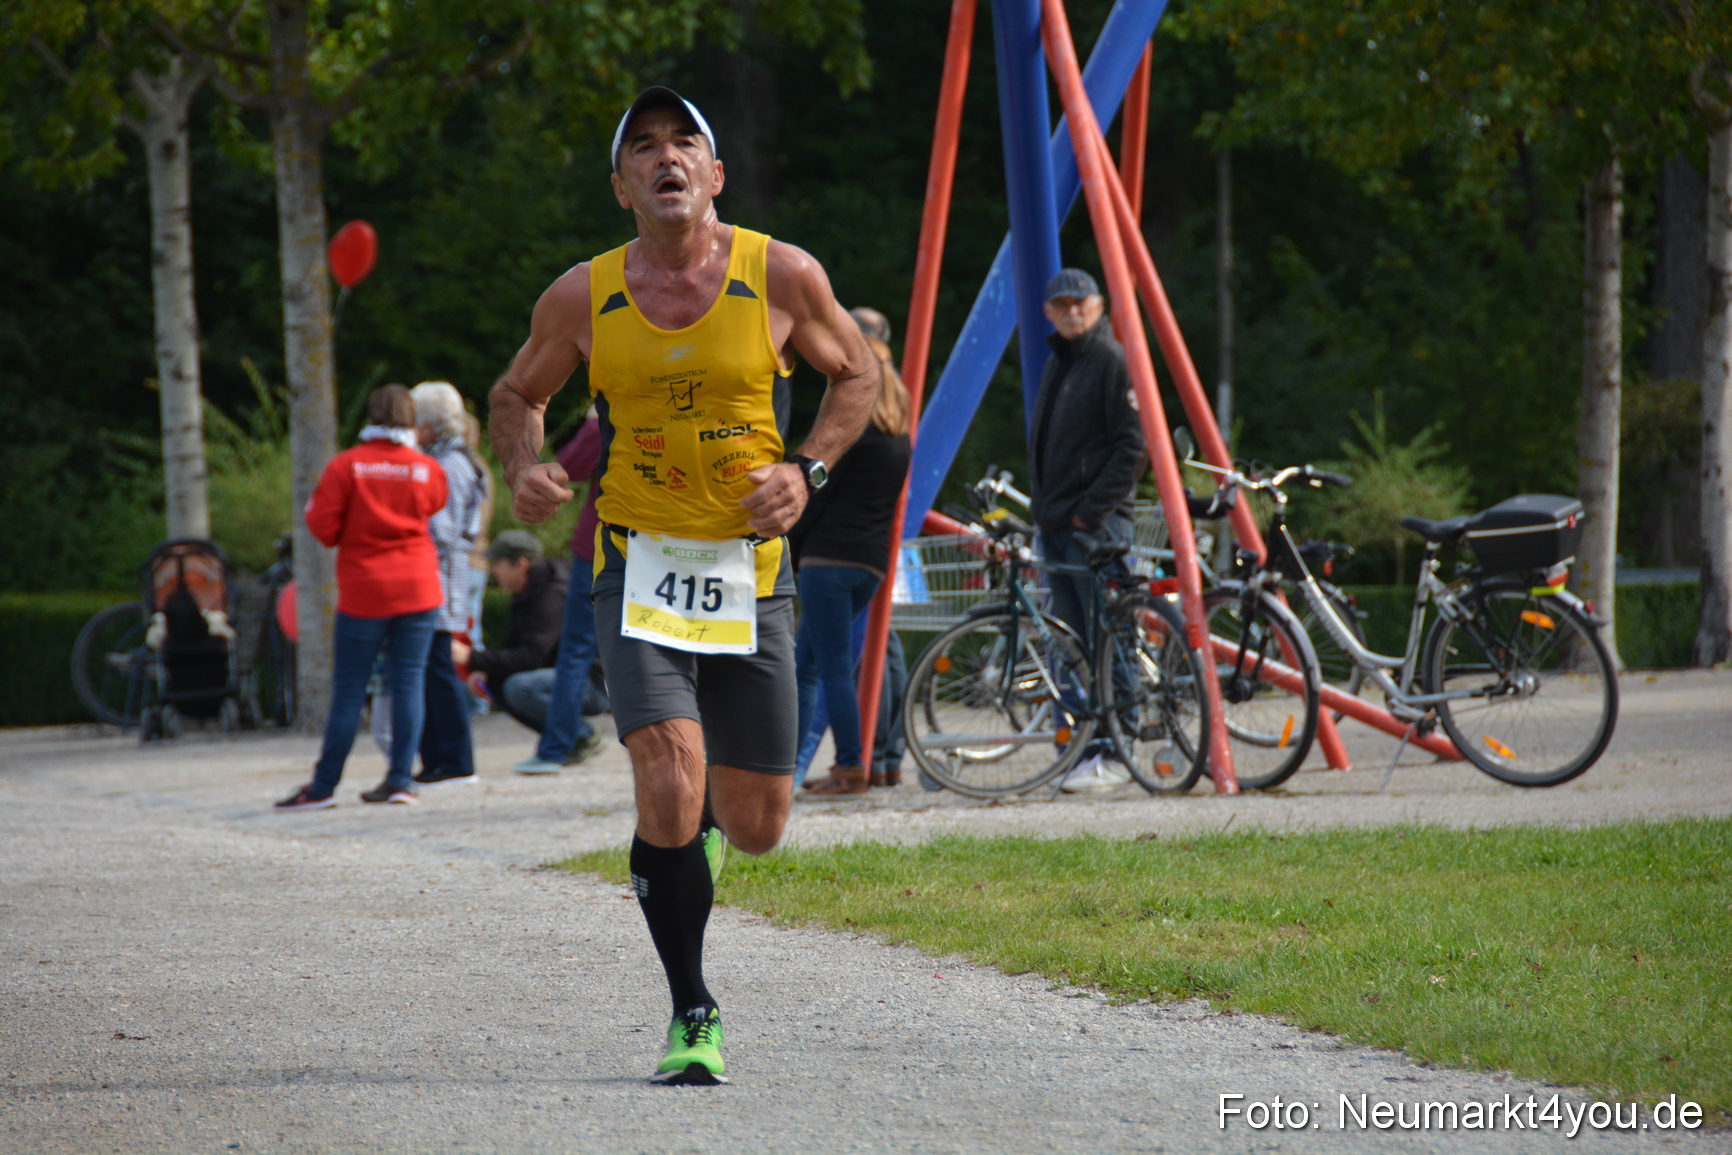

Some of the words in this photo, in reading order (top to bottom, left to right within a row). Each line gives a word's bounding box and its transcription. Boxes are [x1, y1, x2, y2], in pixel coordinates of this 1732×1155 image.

[634, 434, 666, 450] Seidl
[712, 450, 755, 471] PIZZERIA
[674, 548, 718, 561] BOCK
[655, 572, 723, 612] 415
[637, 609, 711, 641] Robert
